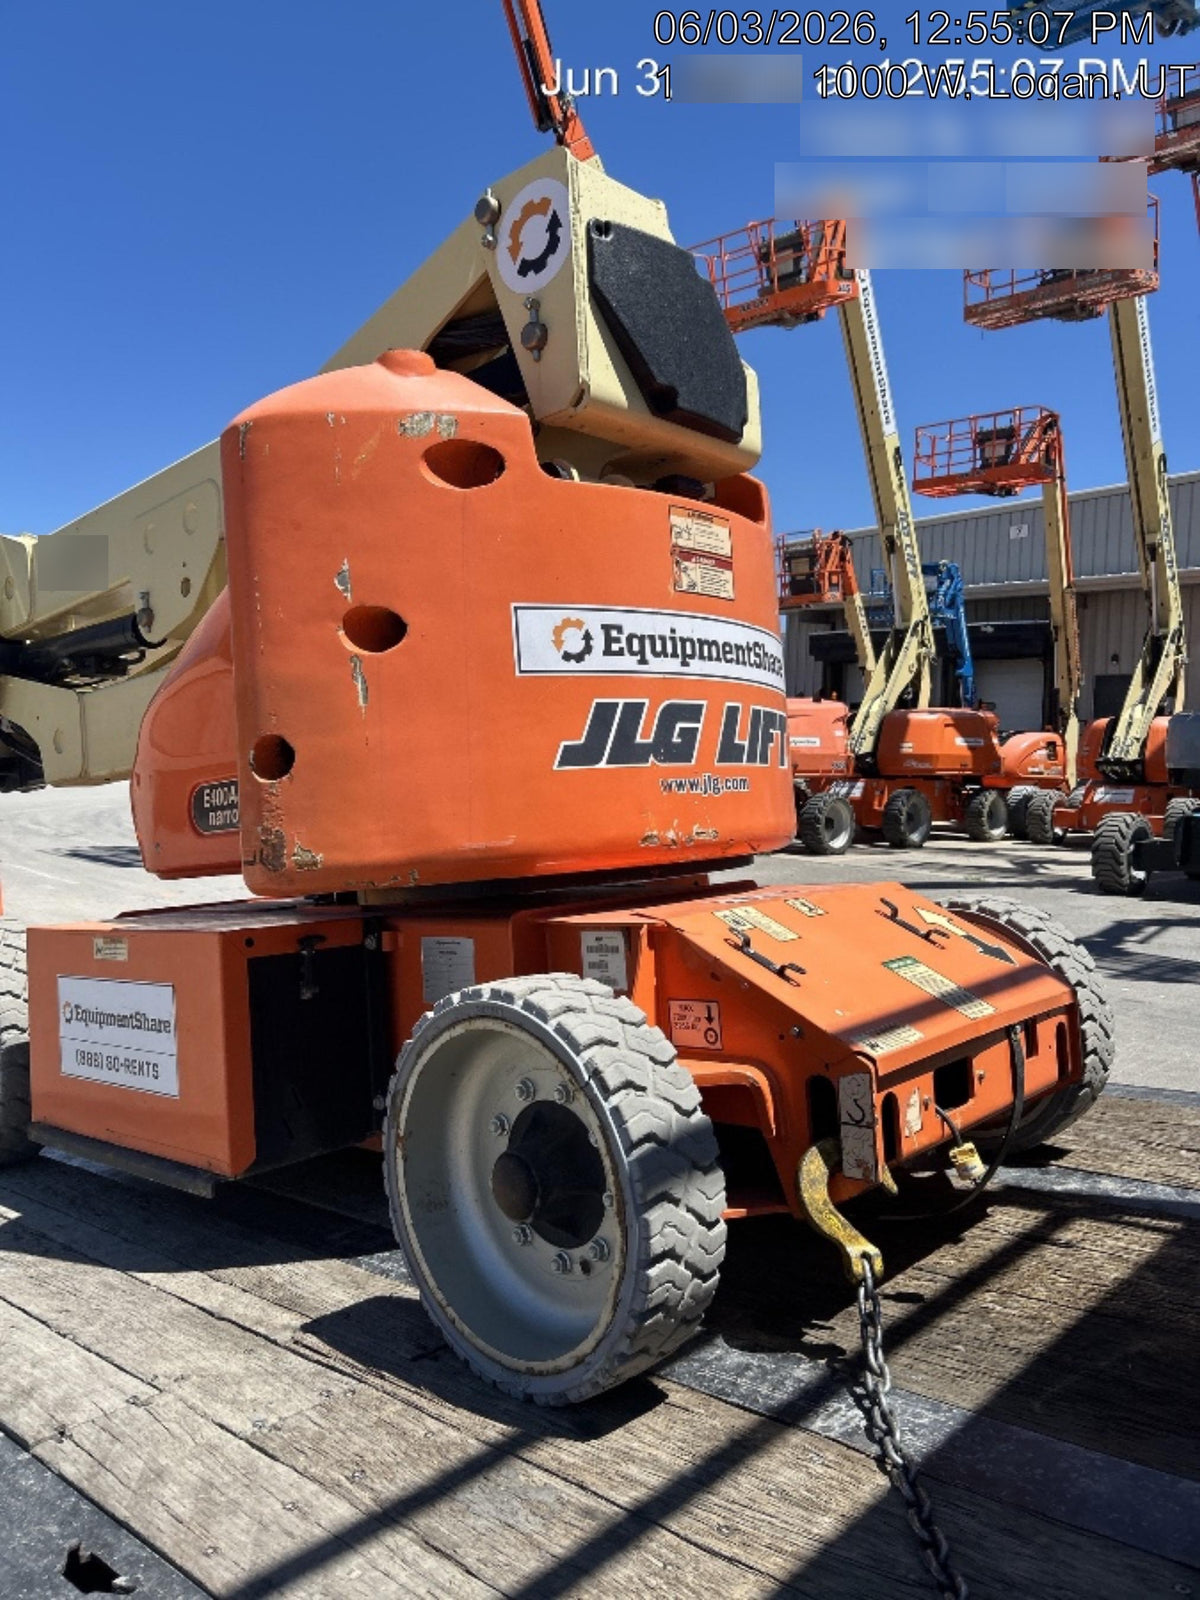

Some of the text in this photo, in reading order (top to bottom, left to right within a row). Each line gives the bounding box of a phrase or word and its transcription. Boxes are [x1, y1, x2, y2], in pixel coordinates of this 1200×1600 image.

[600, 623, 784, 678] EquipmentShare
[553, 699, 708, 770] JLG
[659, 774, 750, 794] www.jlg.com
[209, 808, 239, 826] narro
[74, 1003, 172, 1034] EquipmentShare
